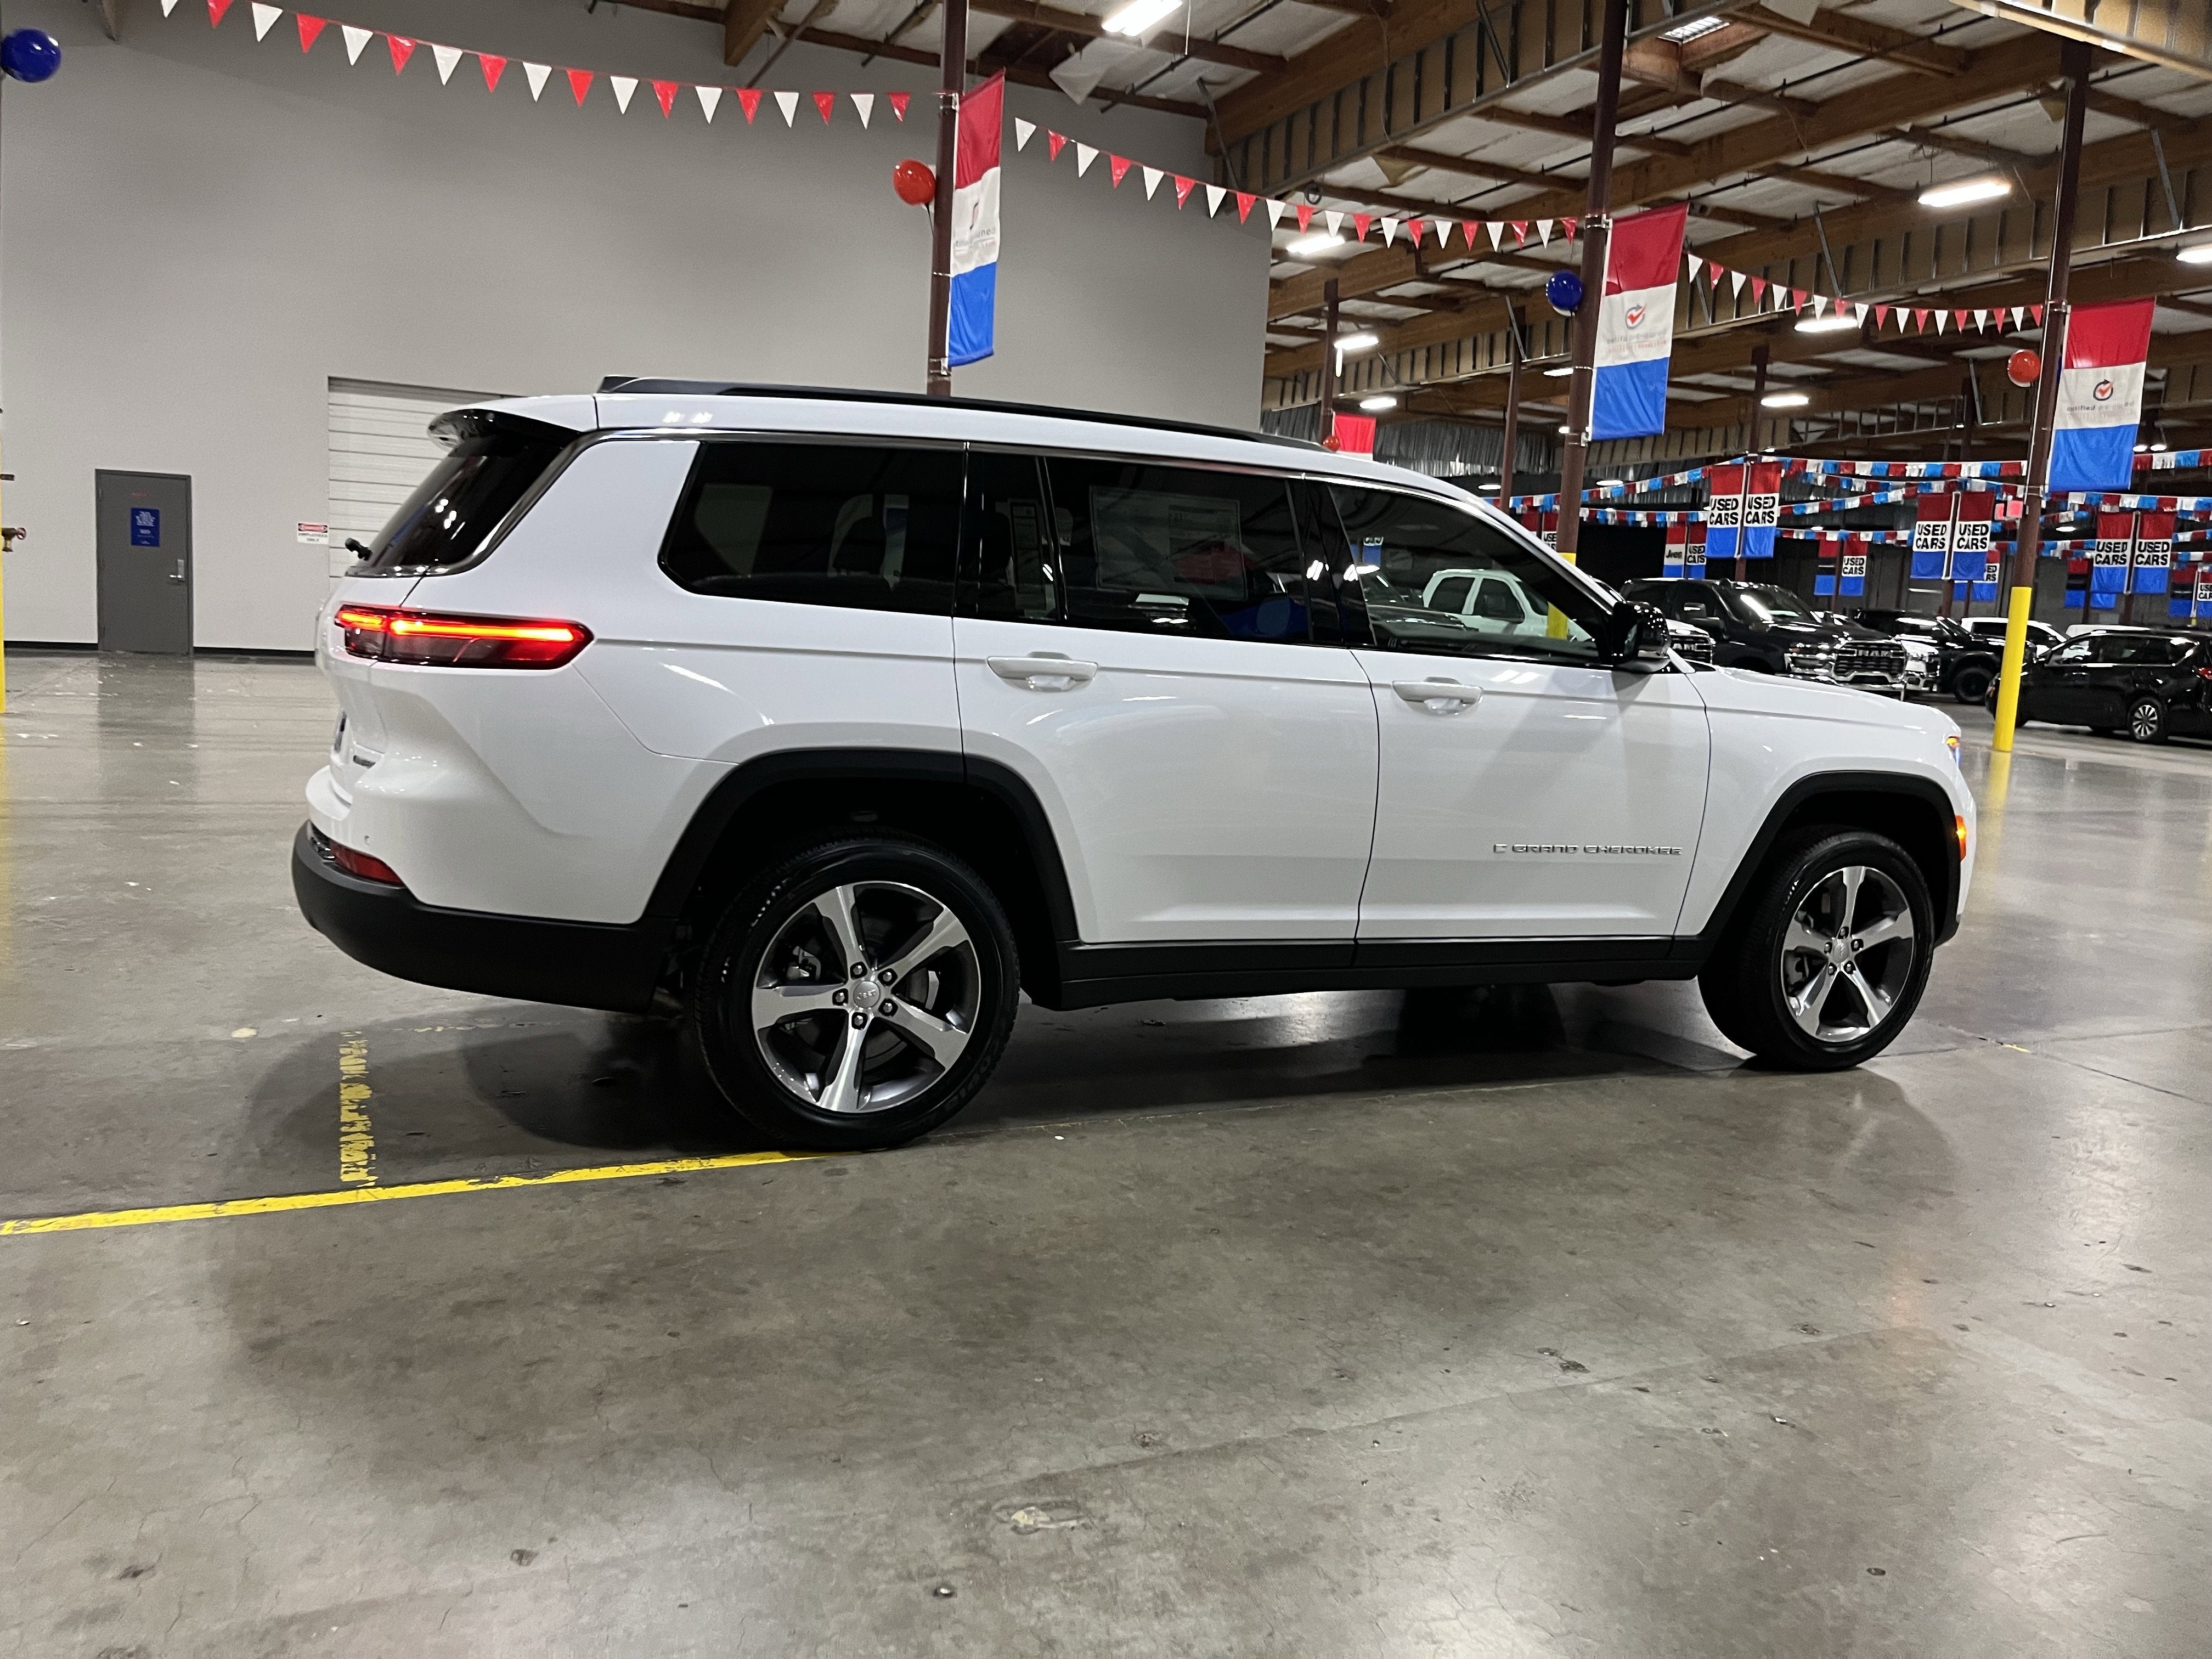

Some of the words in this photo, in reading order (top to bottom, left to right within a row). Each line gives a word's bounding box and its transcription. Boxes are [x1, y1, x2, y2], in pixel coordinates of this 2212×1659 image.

[1711, 498, 1739, 511] USED
[1747, 496, 1776, 510] USED
[1709, 512, 1739, 526] CARS
[1745, 511, 1775, 524] CARS
[1917, 524, 1948, 536] USED
[1959, 524, 1989, 536] USED
[1915, 537, 1946, 550] CARS
[1957, 537, 1988, 550] CARS
[2096, 541, 2128, 553] USED
[2137, 541, 2170, 553] USED
[1689, 545, 1706, 555] USED
[1843, 557, 1865, 566] USED
[2095, 553, 2127, 565] CARS
[2135, 554, 2169, 566] CARS
[1842, 566, 1864, 575] CARS
[1512, 843, 1578, 853] GRAND
[1584, 845, 1682, 855] CHEROKEE
